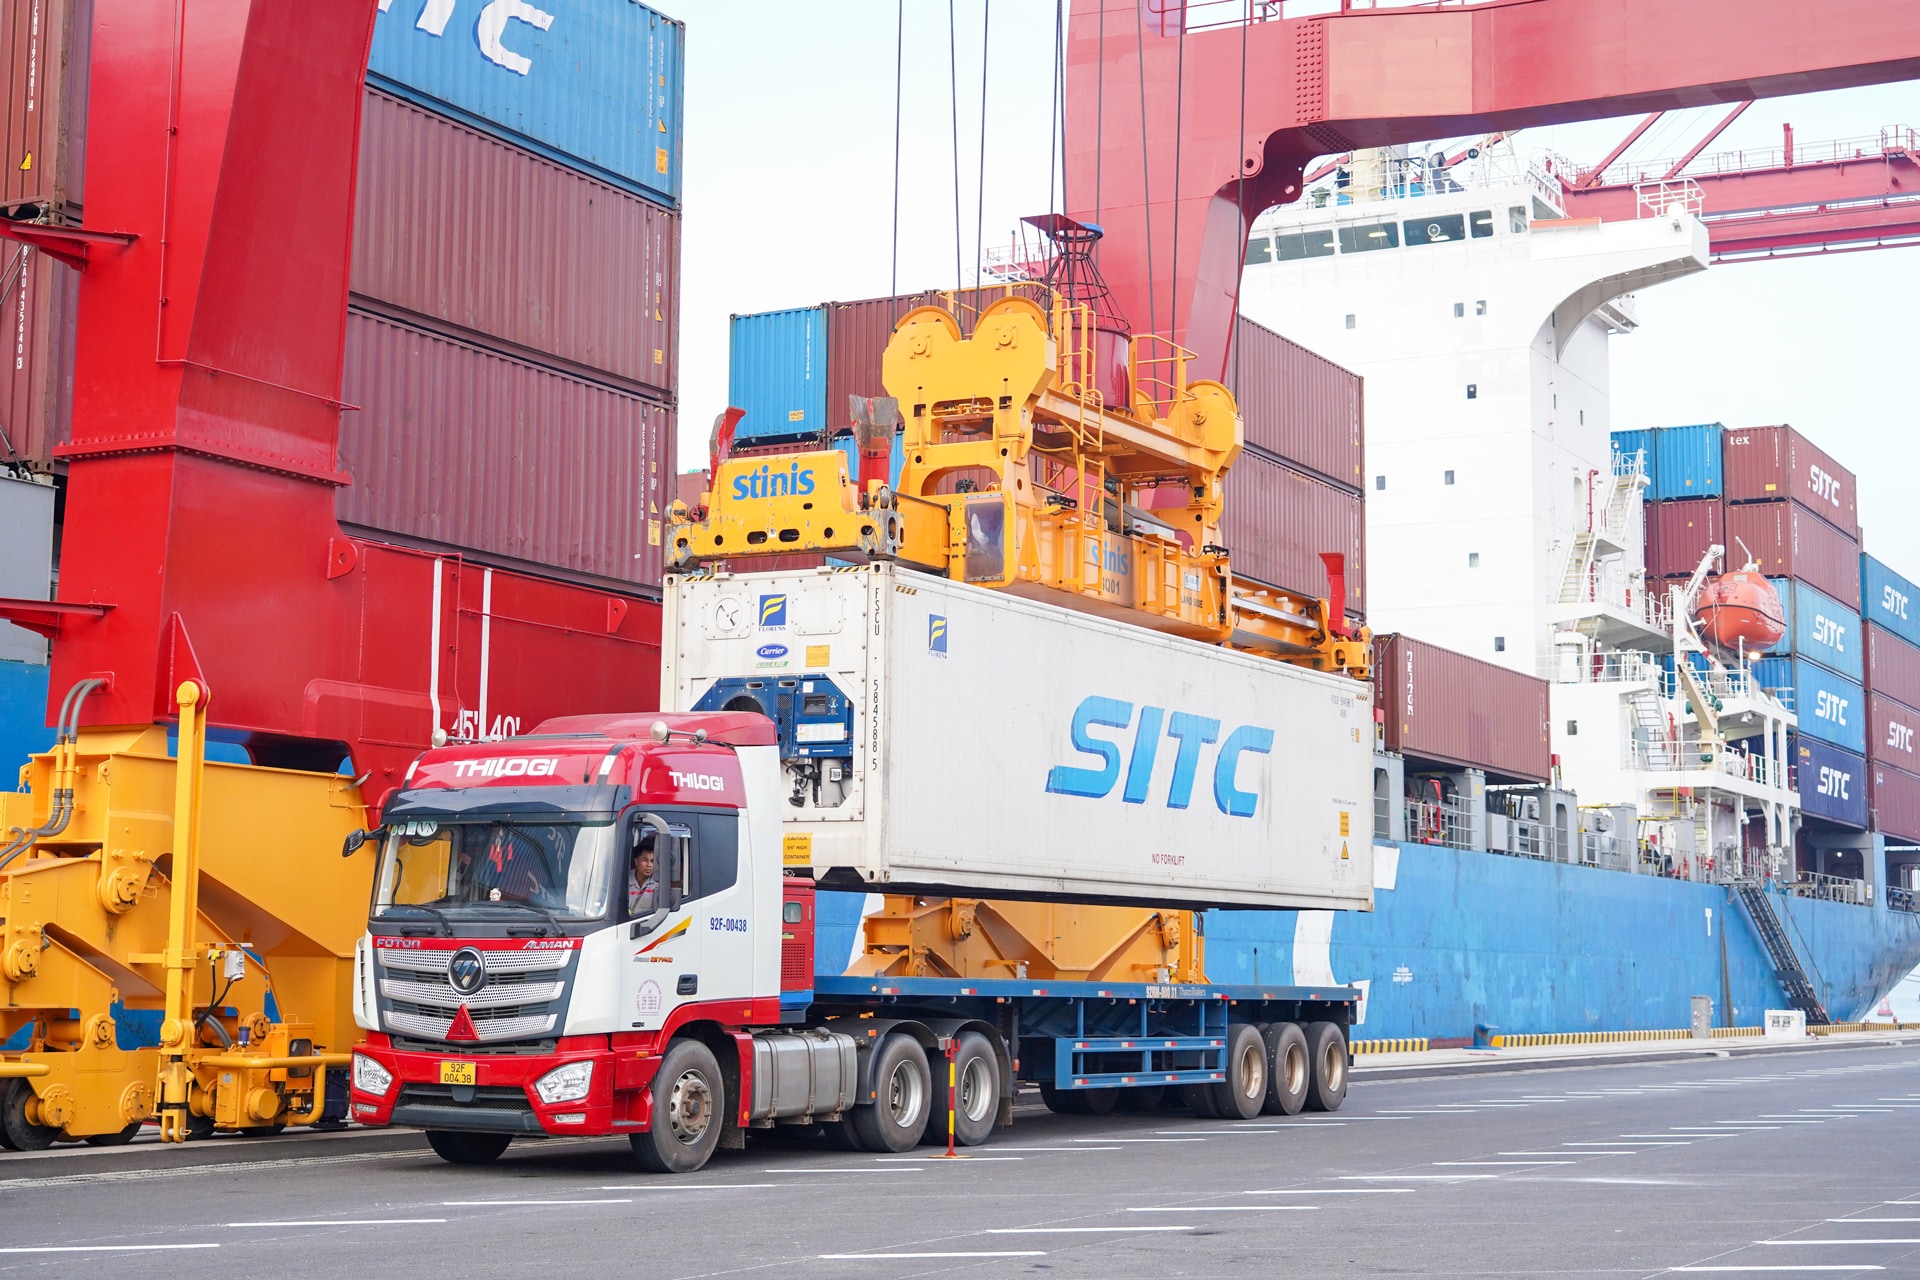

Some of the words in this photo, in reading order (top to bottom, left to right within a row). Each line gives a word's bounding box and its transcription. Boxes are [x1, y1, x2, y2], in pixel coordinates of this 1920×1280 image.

[1730, 435, 1750, 446] tex
[732, 462, 815, 501] stinis
[1808, 464, 1840, 508] SITC
[1091, 540, 1129, 576] sinis
[1881, 584, 1909, 621] SITC
[1812, 614, 1846, 653] SITC
[760, 647, 785, 655] Carrier
[1815, 689, 1849, 726] SITC
[1887, 721, 1914, 753] SITC
[872, 758, 878, 771] 5
[1045, 695, 1275, 818] SITC
[453, 758, 559, 778] THILOGI
[668, 771, 724, 791] THILOGI
[1817, 766, 1851, 801] SITC
[1151, 853, 1160, 864] NO
[1161, 854, 1185, 866] FORKLIFT
[710, 917, 747, 932] 92F-00438
[376, 939, 421, 948] FOTON
[522, 940, 574, 949] AUMAN
[450, 1063, 465, 1073] 92F
